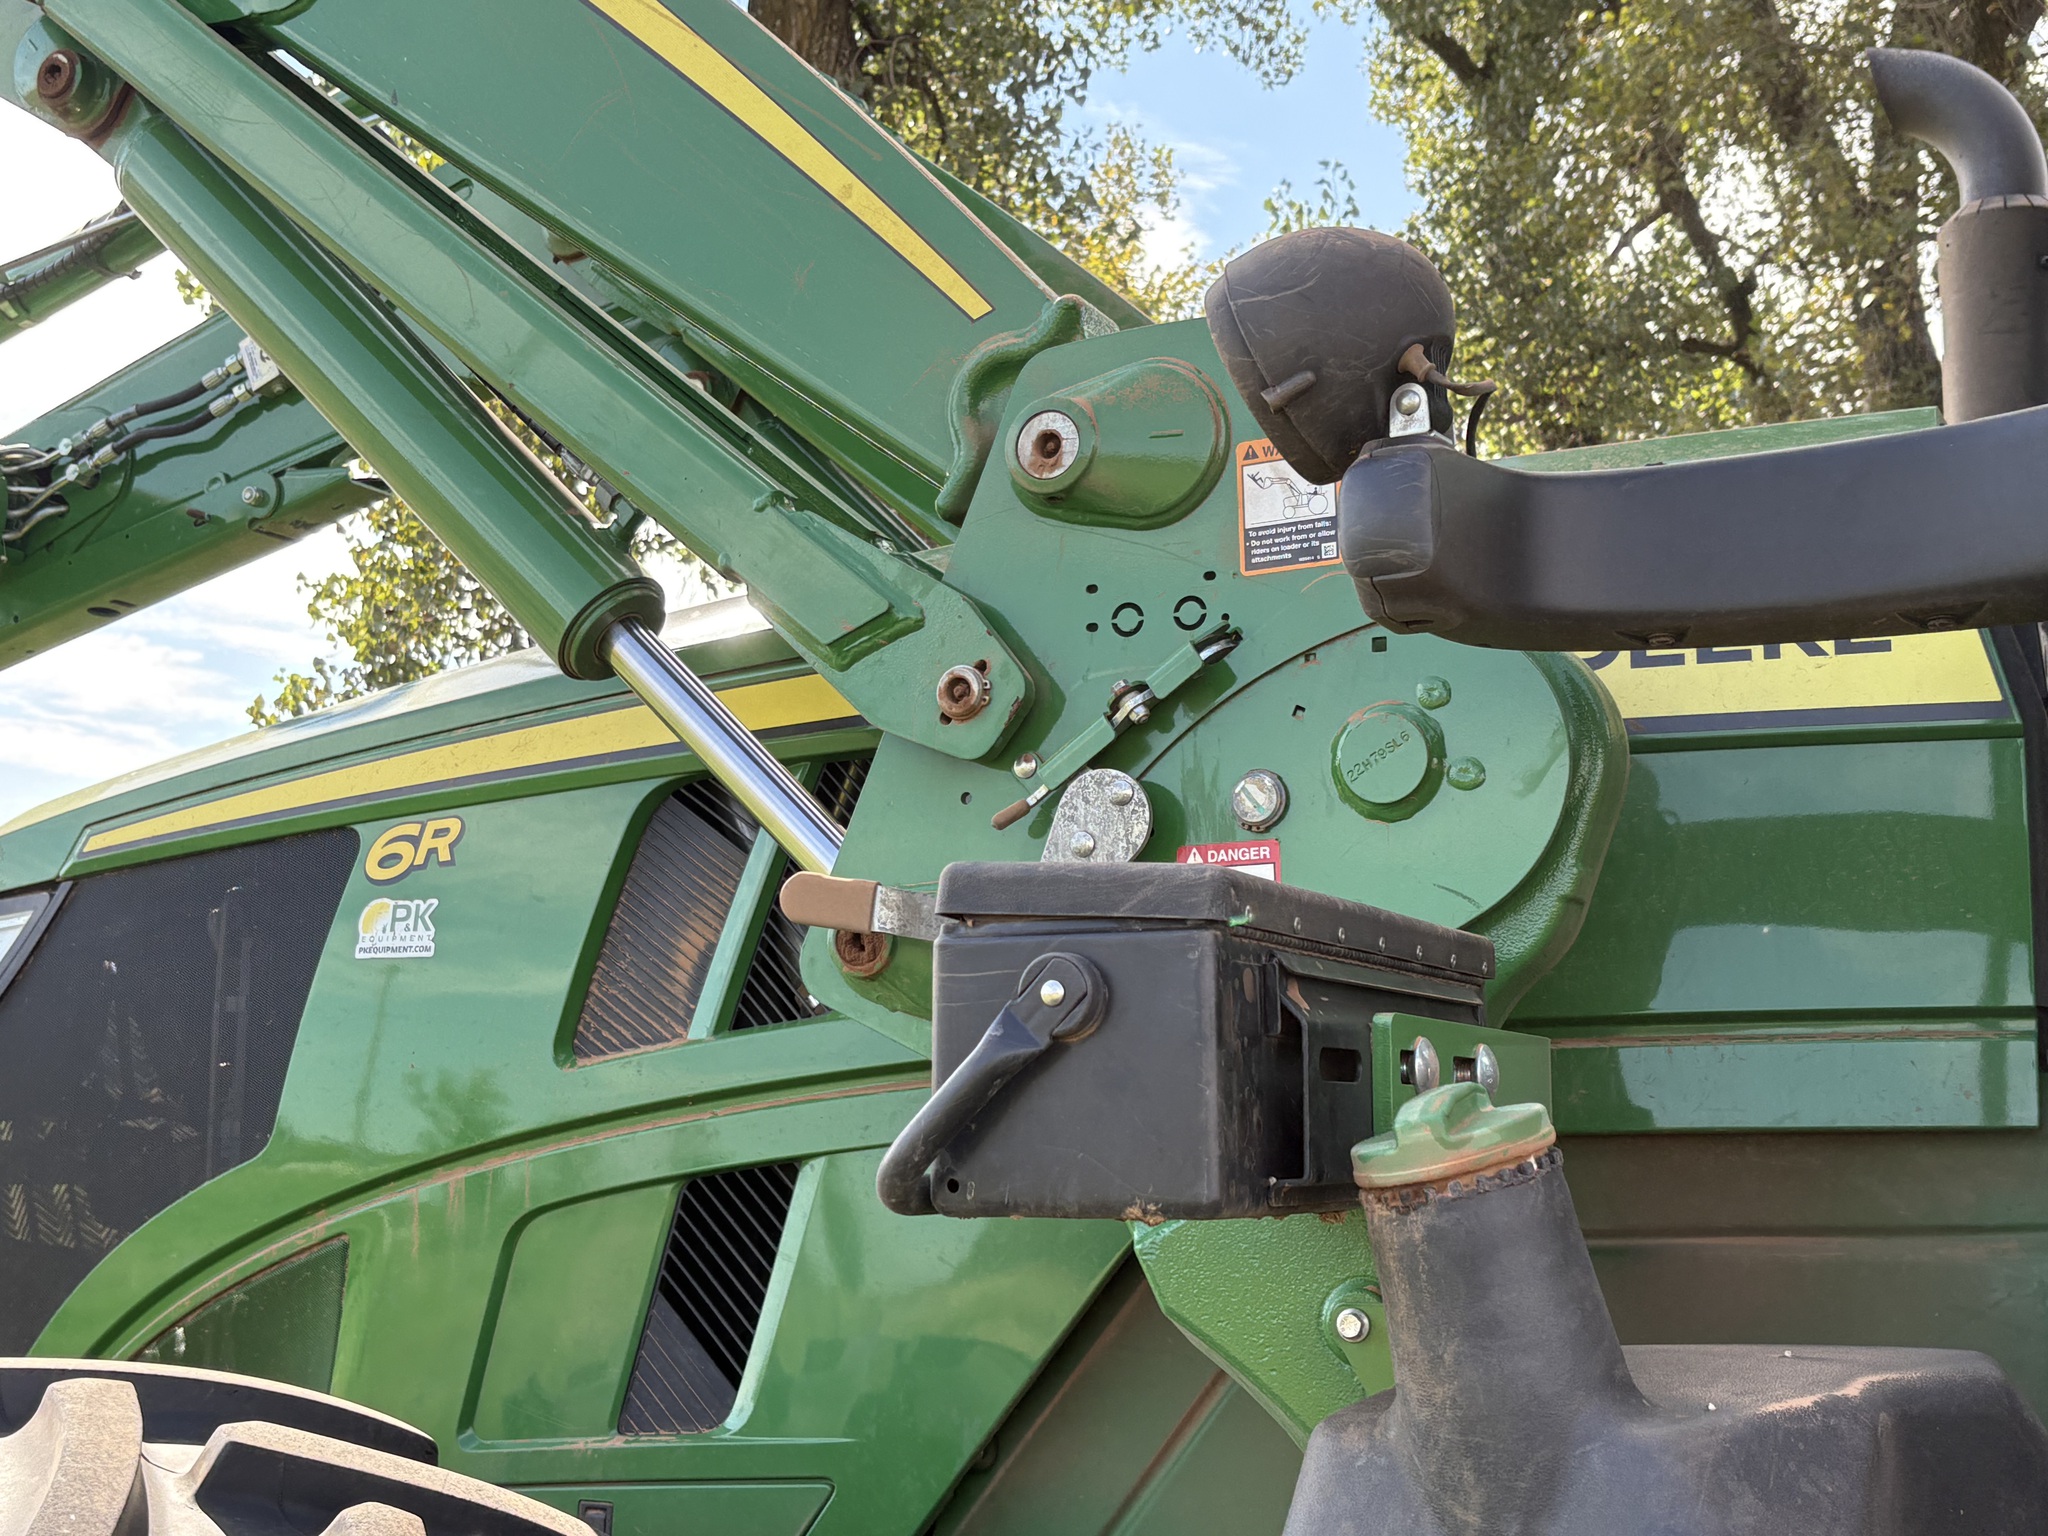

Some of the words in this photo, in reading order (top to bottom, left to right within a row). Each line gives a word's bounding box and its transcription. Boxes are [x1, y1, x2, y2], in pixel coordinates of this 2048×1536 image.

[1257, 528, 1276, 536] avoid
[1277, 525, 1296, 534] injury
[1297, 522, 1314, 530] from
[1314, 520, 1332, 528] falls:
[1274, 535, 1291, 543] work
[1291, 533, 1308, 541] from
[1317, 530, 1336, 538] allow
[1250, 546, 1270, 555] riders
[1280, 543, 1302, 551] loader
[1250, 552, 1292, 563] attachments
[364, 815, 465, 885] 6R
[1207, 846, 1271, 863] DANGER
[390, 903, 435, 933] P&K
[361, 934, 433, 944] EQUIPMENT
[358, 944, 433, 955] PKEQUIPMENT.COM
